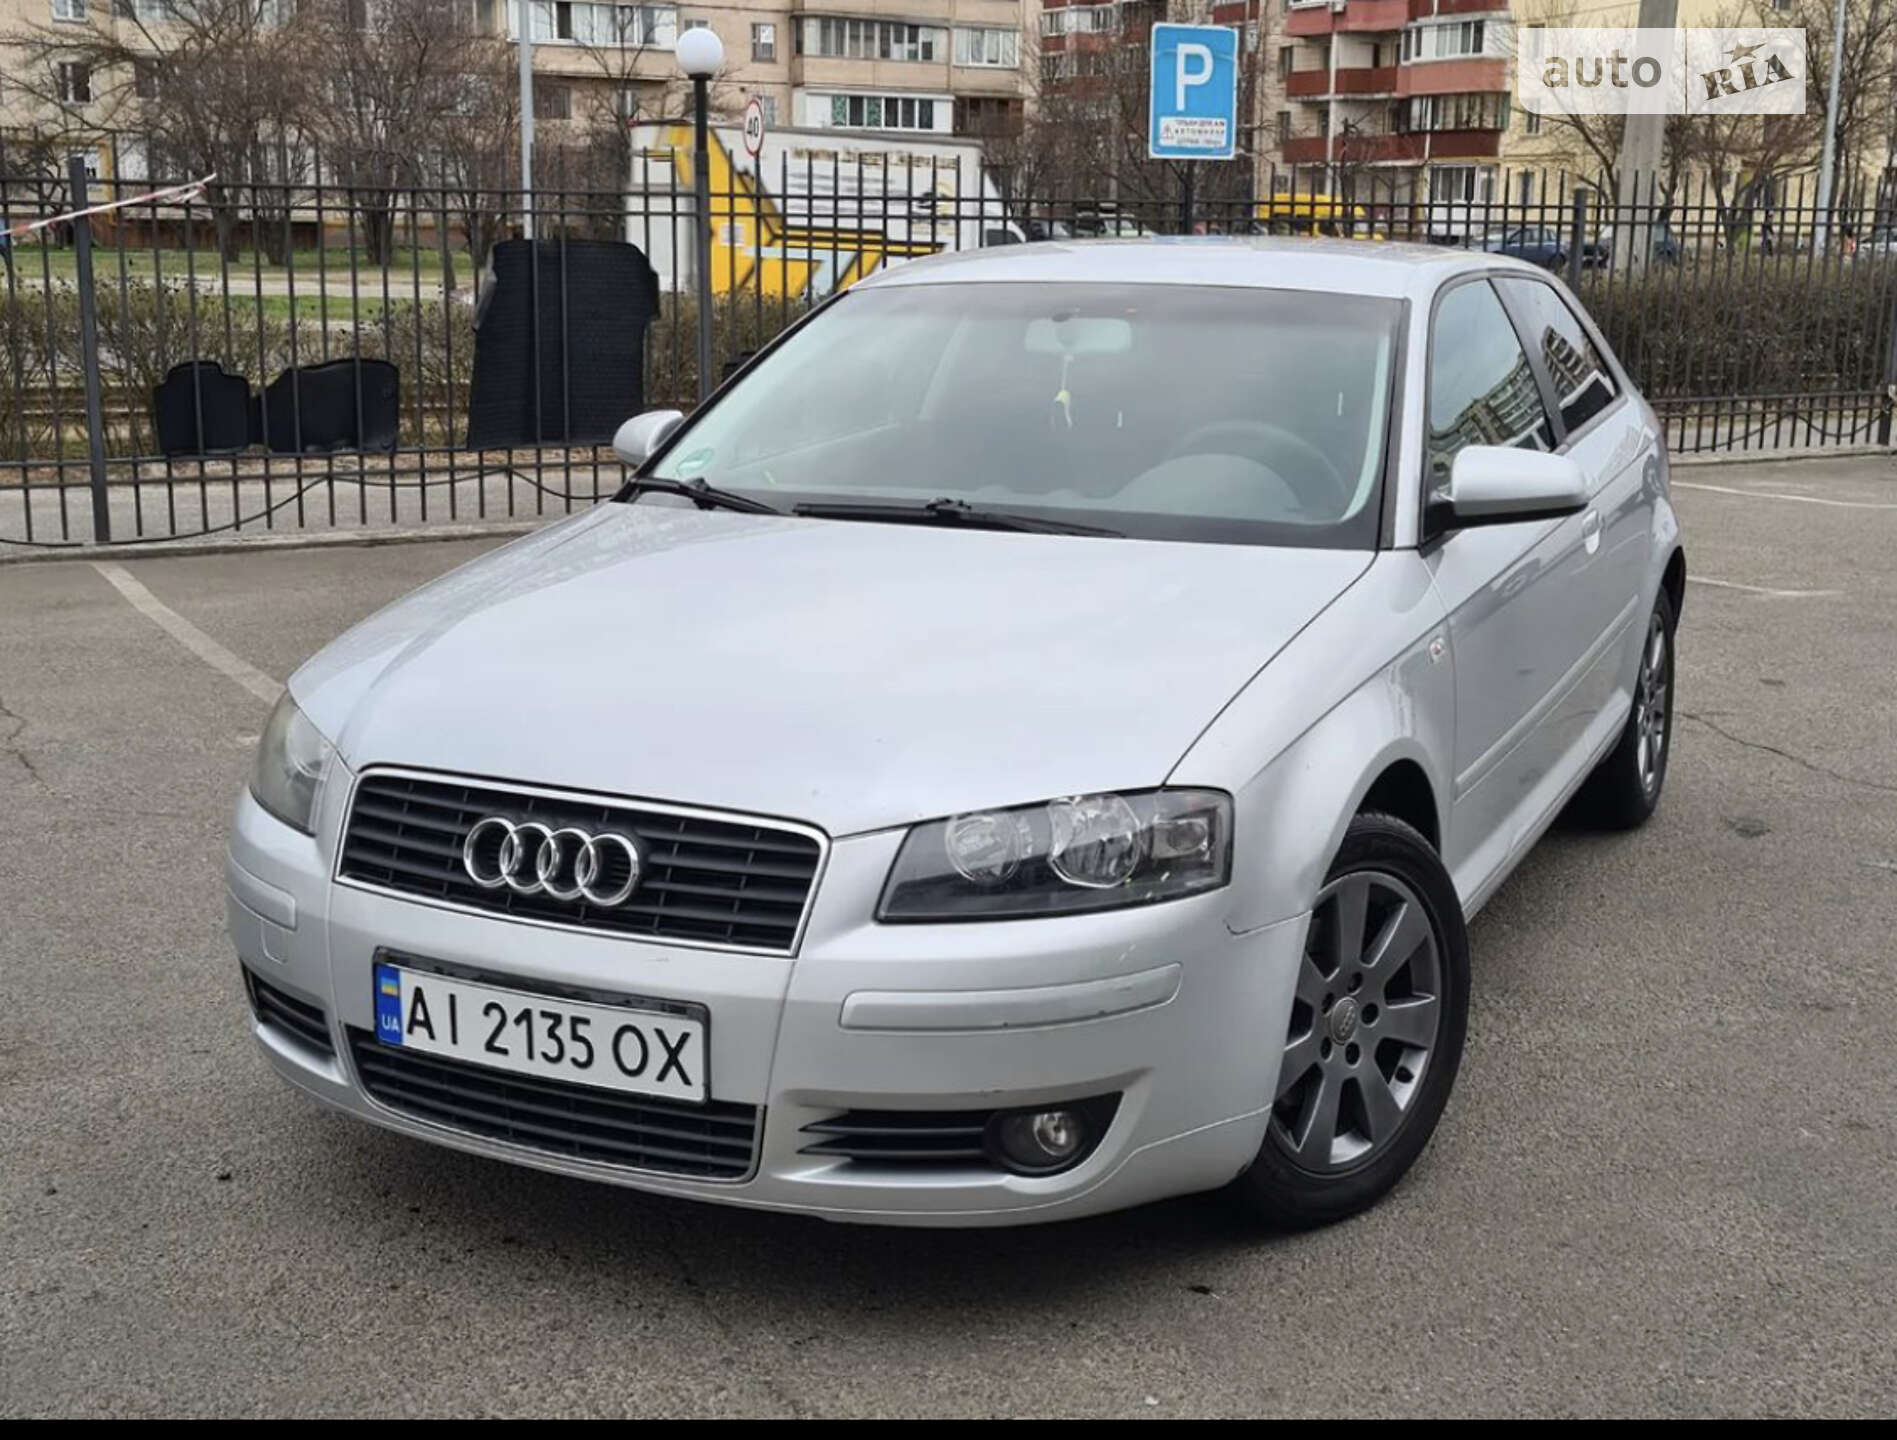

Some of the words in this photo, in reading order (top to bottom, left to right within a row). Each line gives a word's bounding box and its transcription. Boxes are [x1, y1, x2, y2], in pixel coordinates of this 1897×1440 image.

[1176, 43, 1213, 111] P
[747, 116, 760, 138] 40
[382, 1014, 400, 1033] UA
[407, 986, 458, 1046] AI
[482, 1001, 595, 1069] 2135
[612, 1024, 693, 1086] OX
